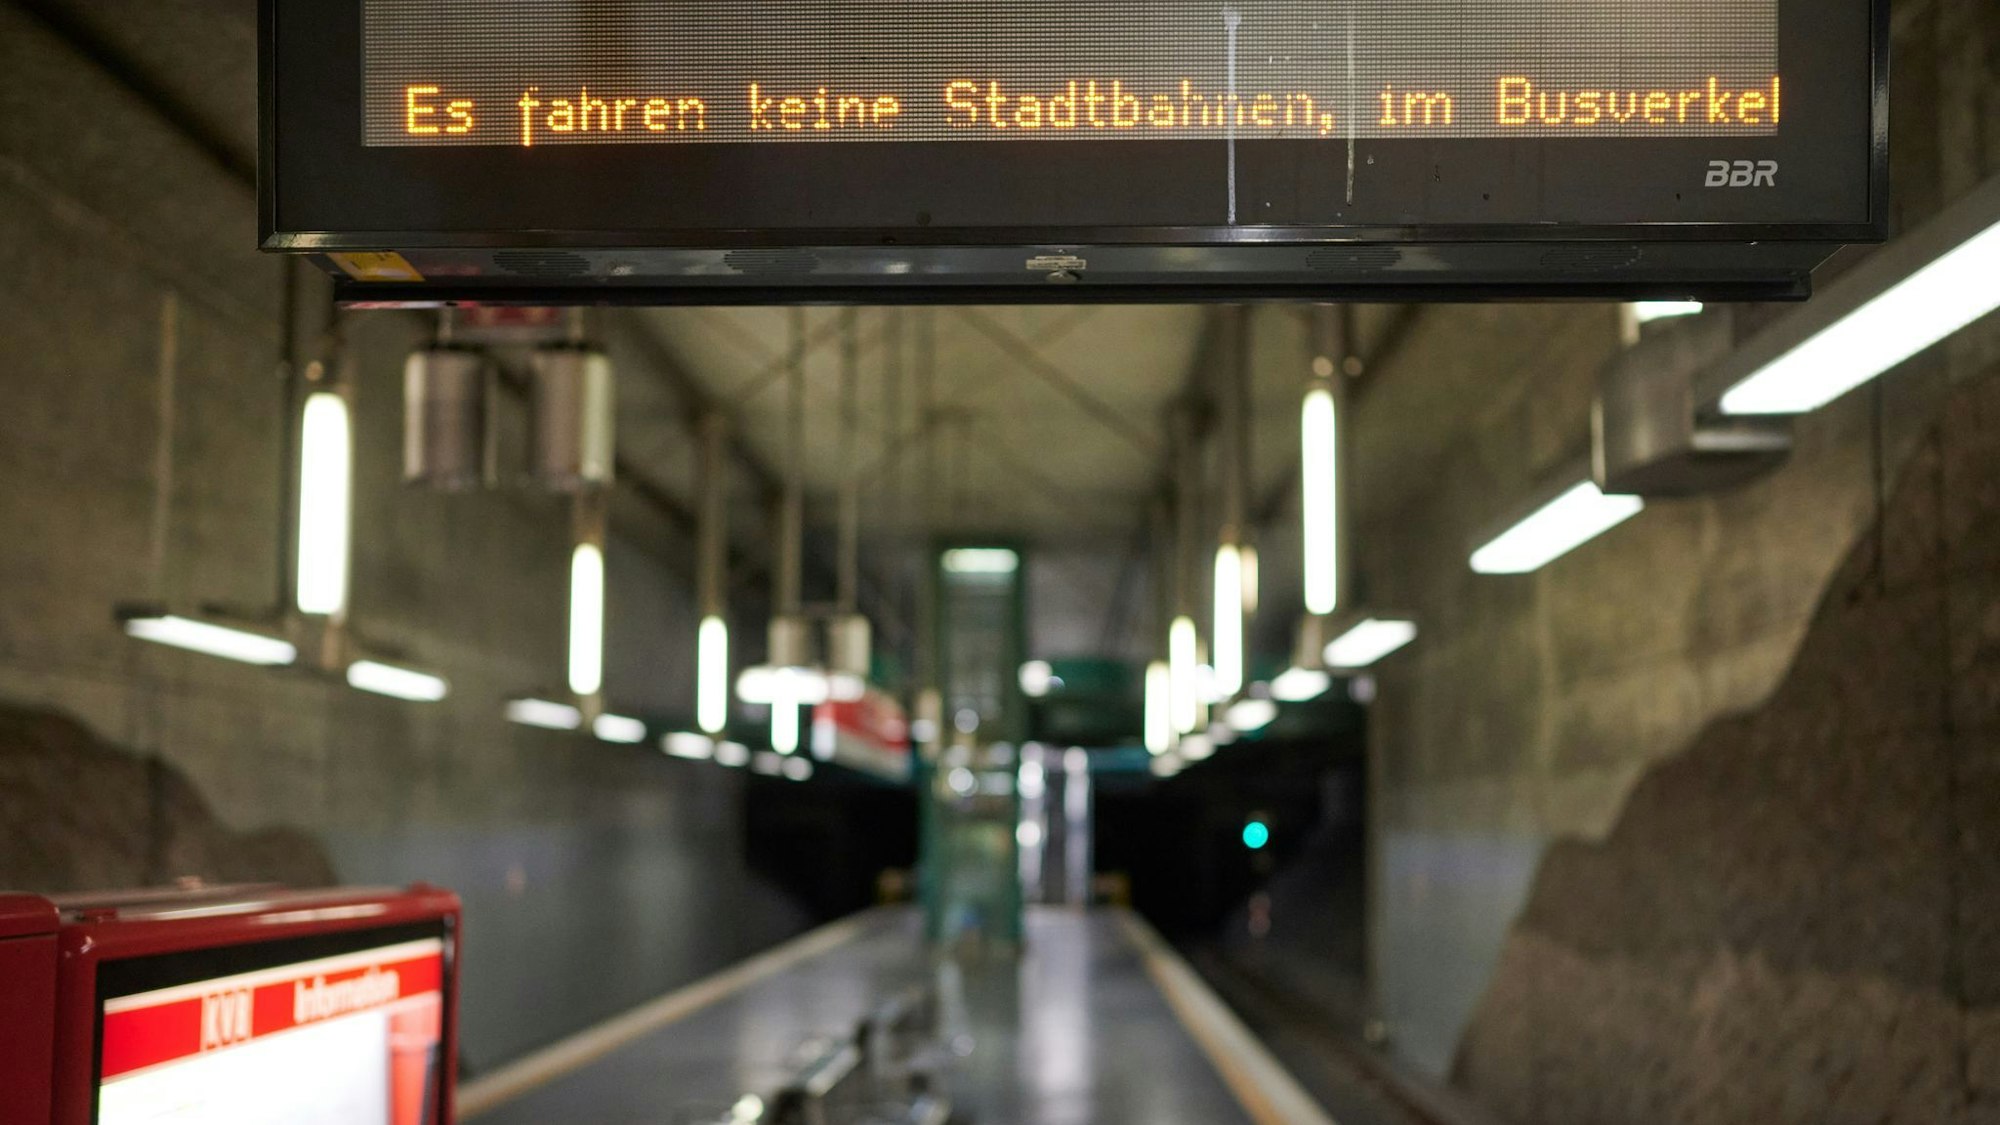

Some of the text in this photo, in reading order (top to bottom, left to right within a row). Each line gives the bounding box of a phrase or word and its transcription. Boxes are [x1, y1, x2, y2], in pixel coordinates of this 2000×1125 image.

[406, 76, 1780, 147] Es fahren keine Stadtbahnen, im Busverke
[1704, 160, 1778, 187] BBR
